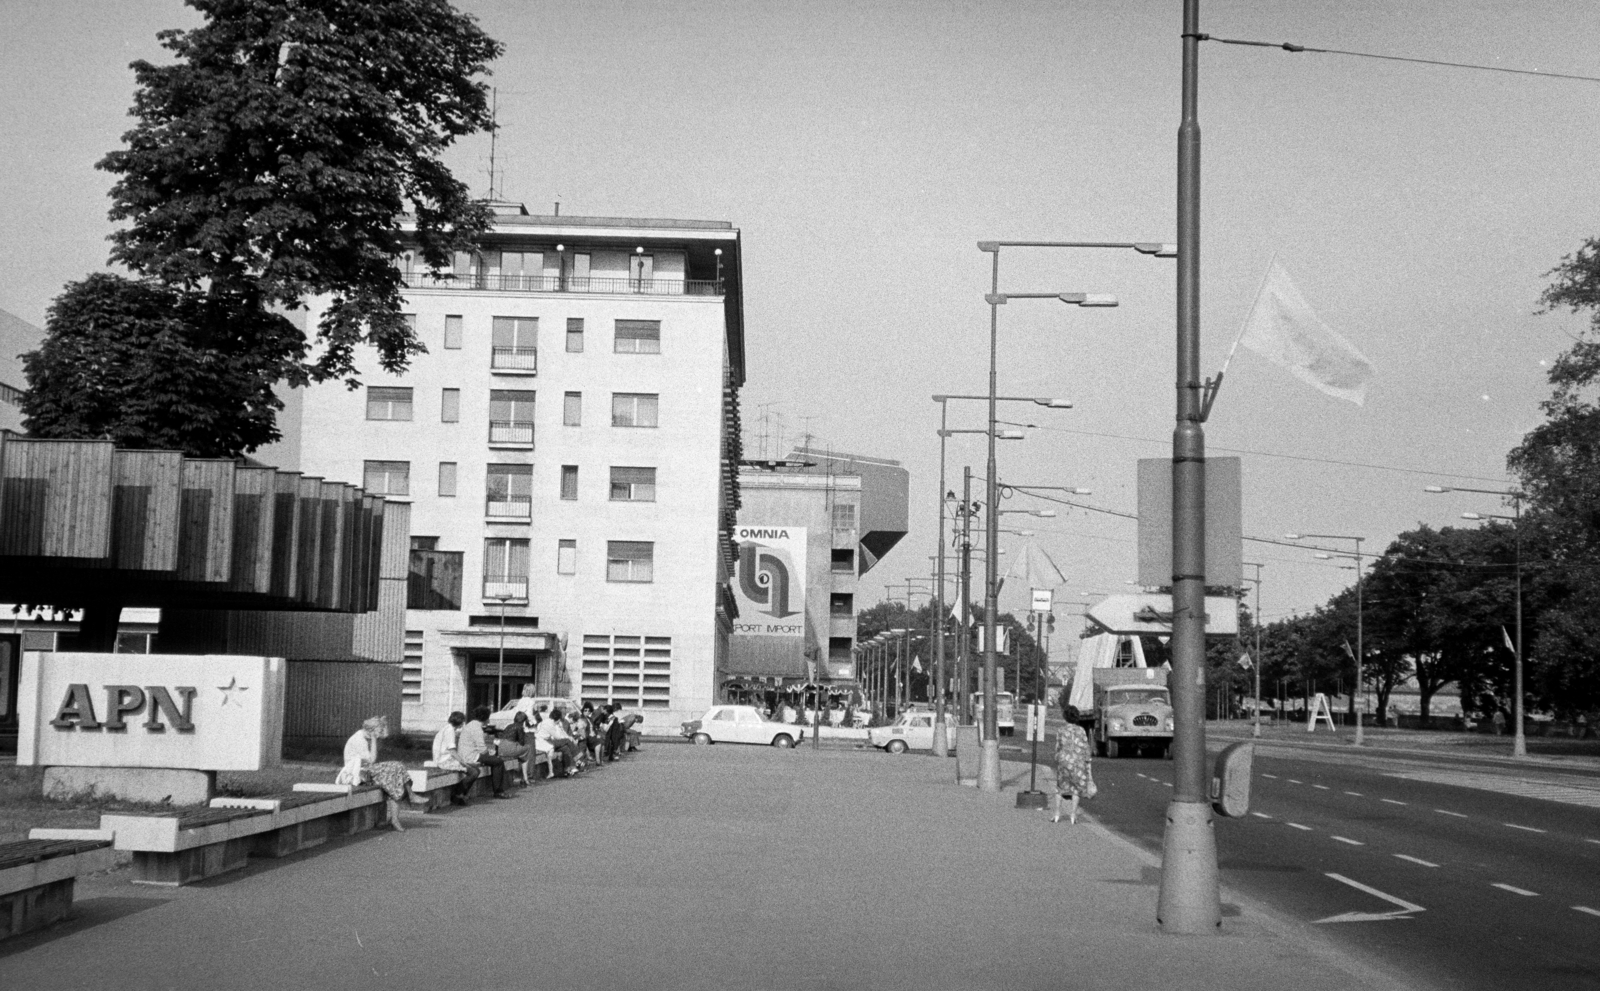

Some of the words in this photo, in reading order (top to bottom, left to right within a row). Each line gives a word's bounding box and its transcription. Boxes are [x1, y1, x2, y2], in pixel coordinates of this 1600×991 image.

[740, 529, 790, 539] OMNIA
[766, 625, 803, 633] IMPORT
[49, 684, 198, 733] APN
